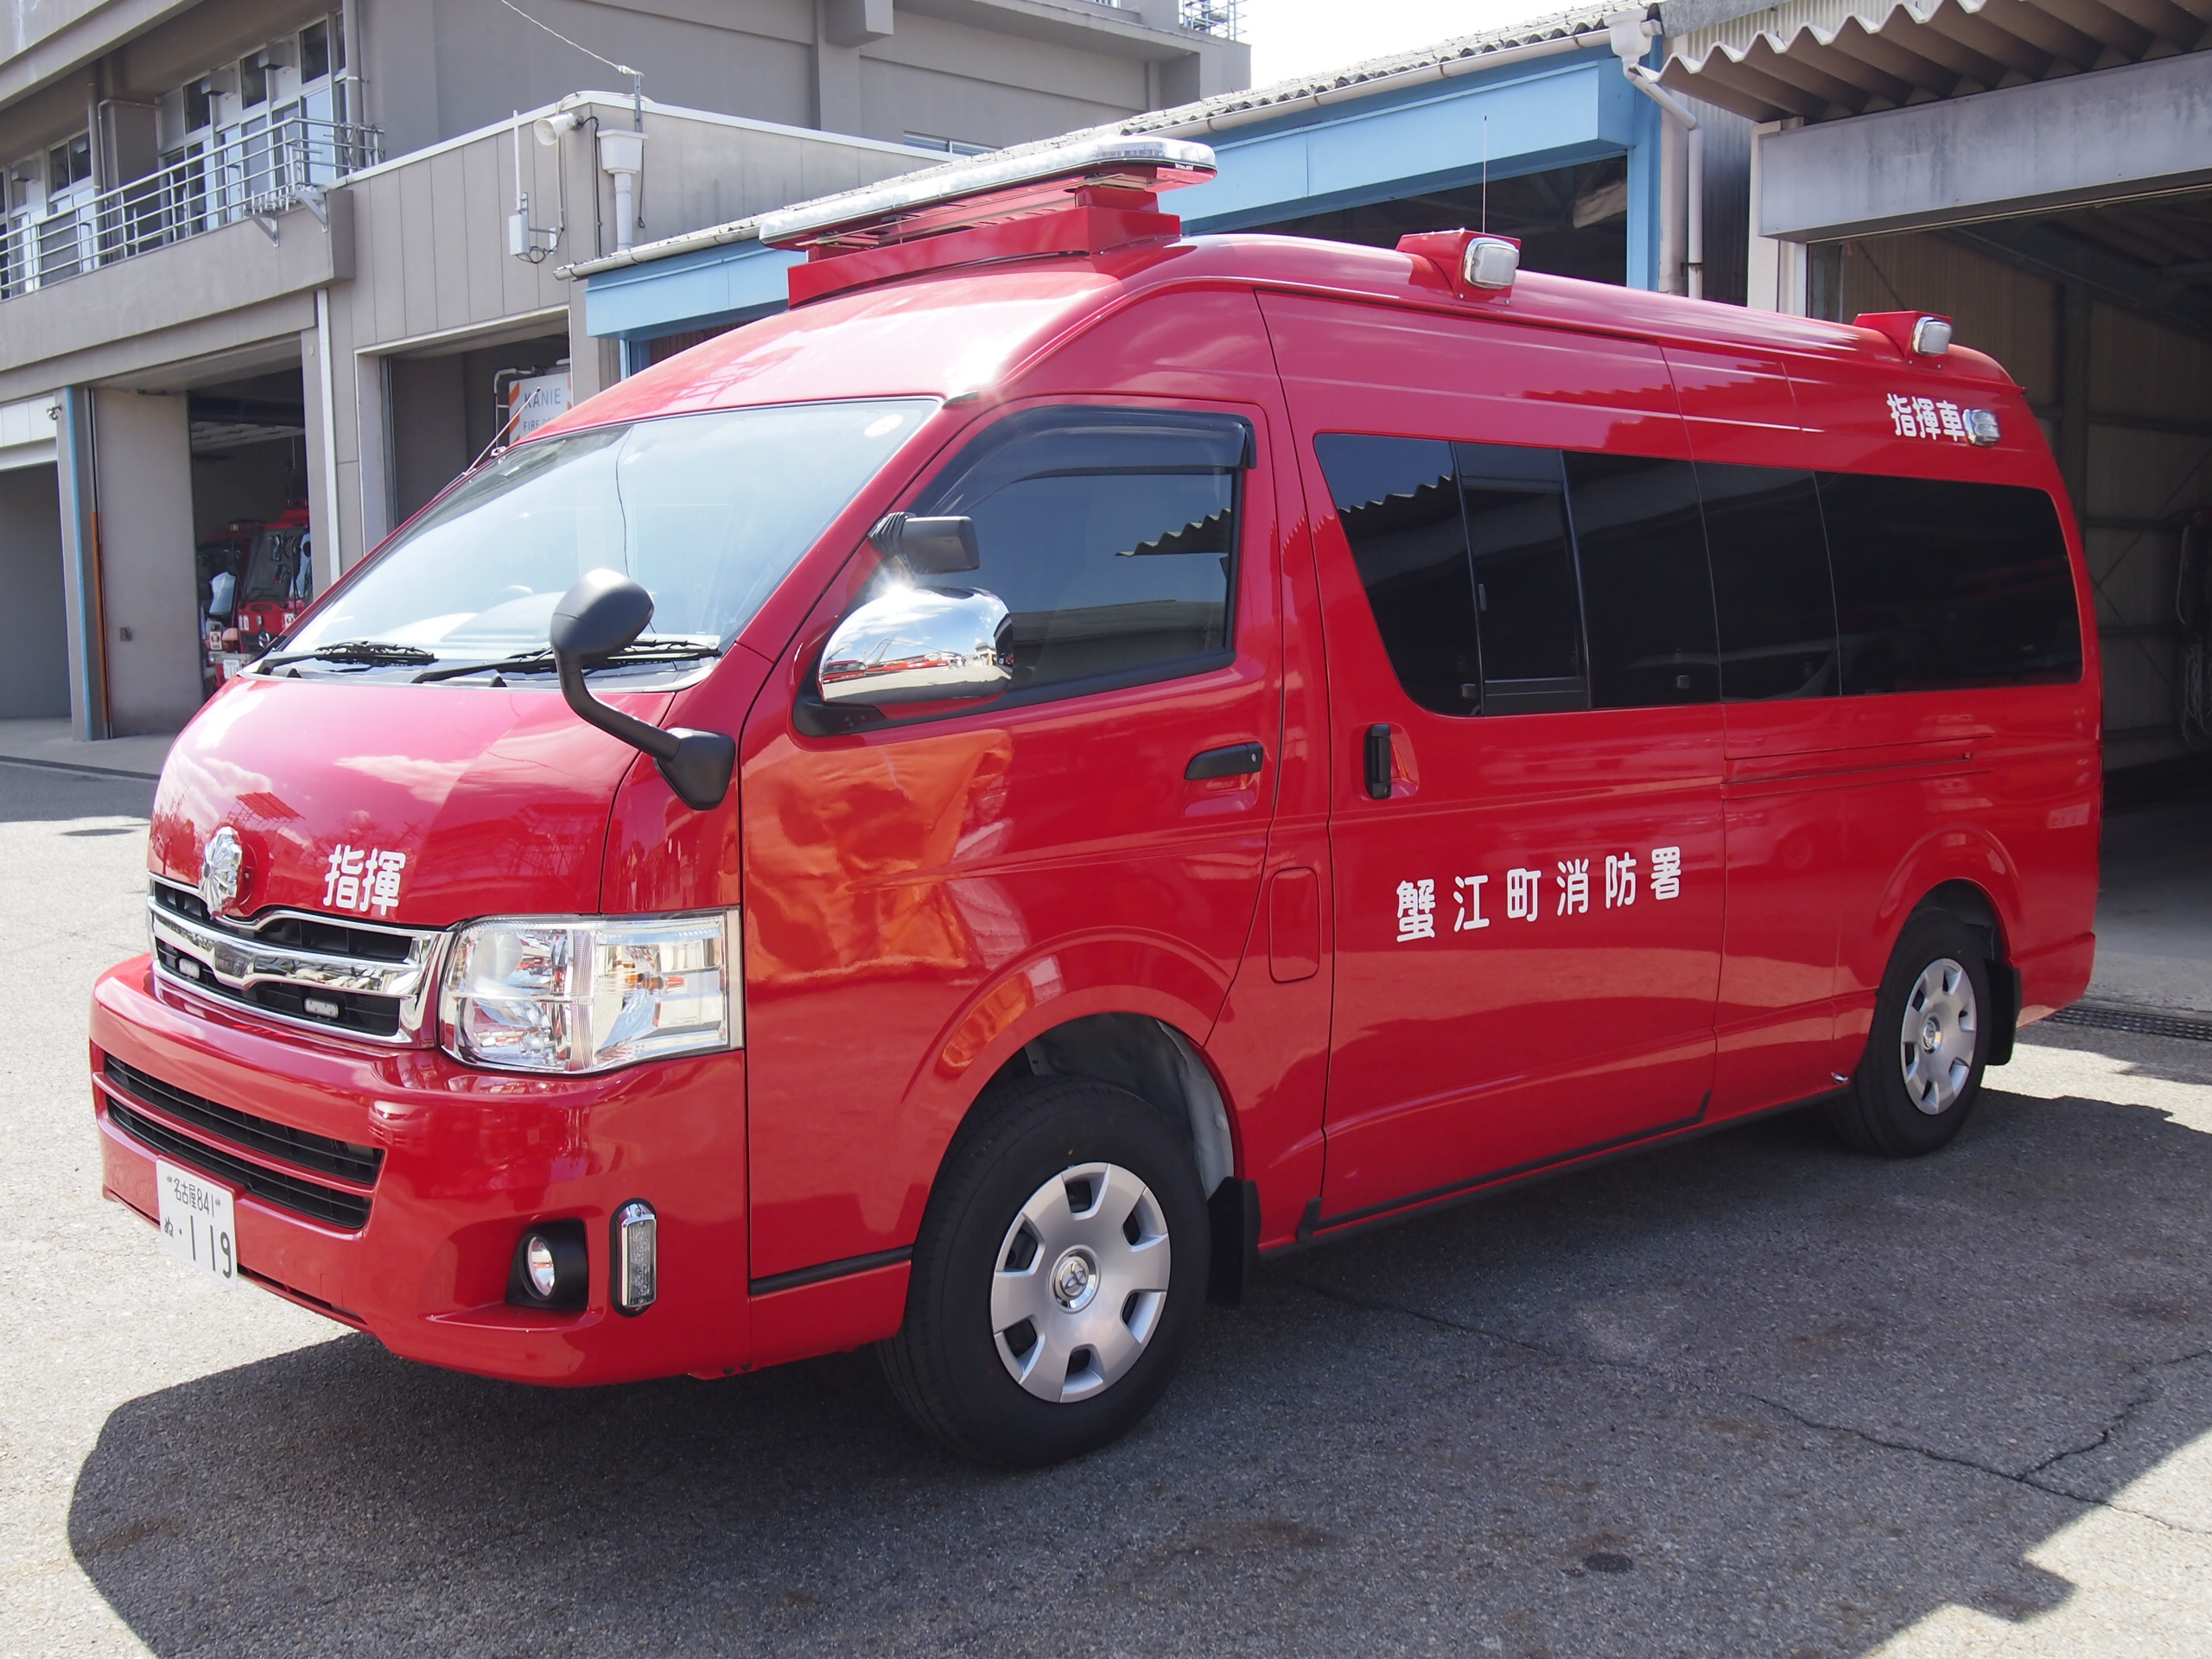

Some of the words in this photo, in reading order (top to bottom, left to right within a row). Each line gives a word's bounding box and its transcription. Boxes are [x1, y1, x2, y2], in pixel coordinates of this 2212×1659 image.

[524, 388, 561, 409] KANIE
[1886, 392, 1965, 442] 指揮車
[322, 843, 406, 917] 指揮
[1396, 846, 1681, 943] 蟹江町消防署
